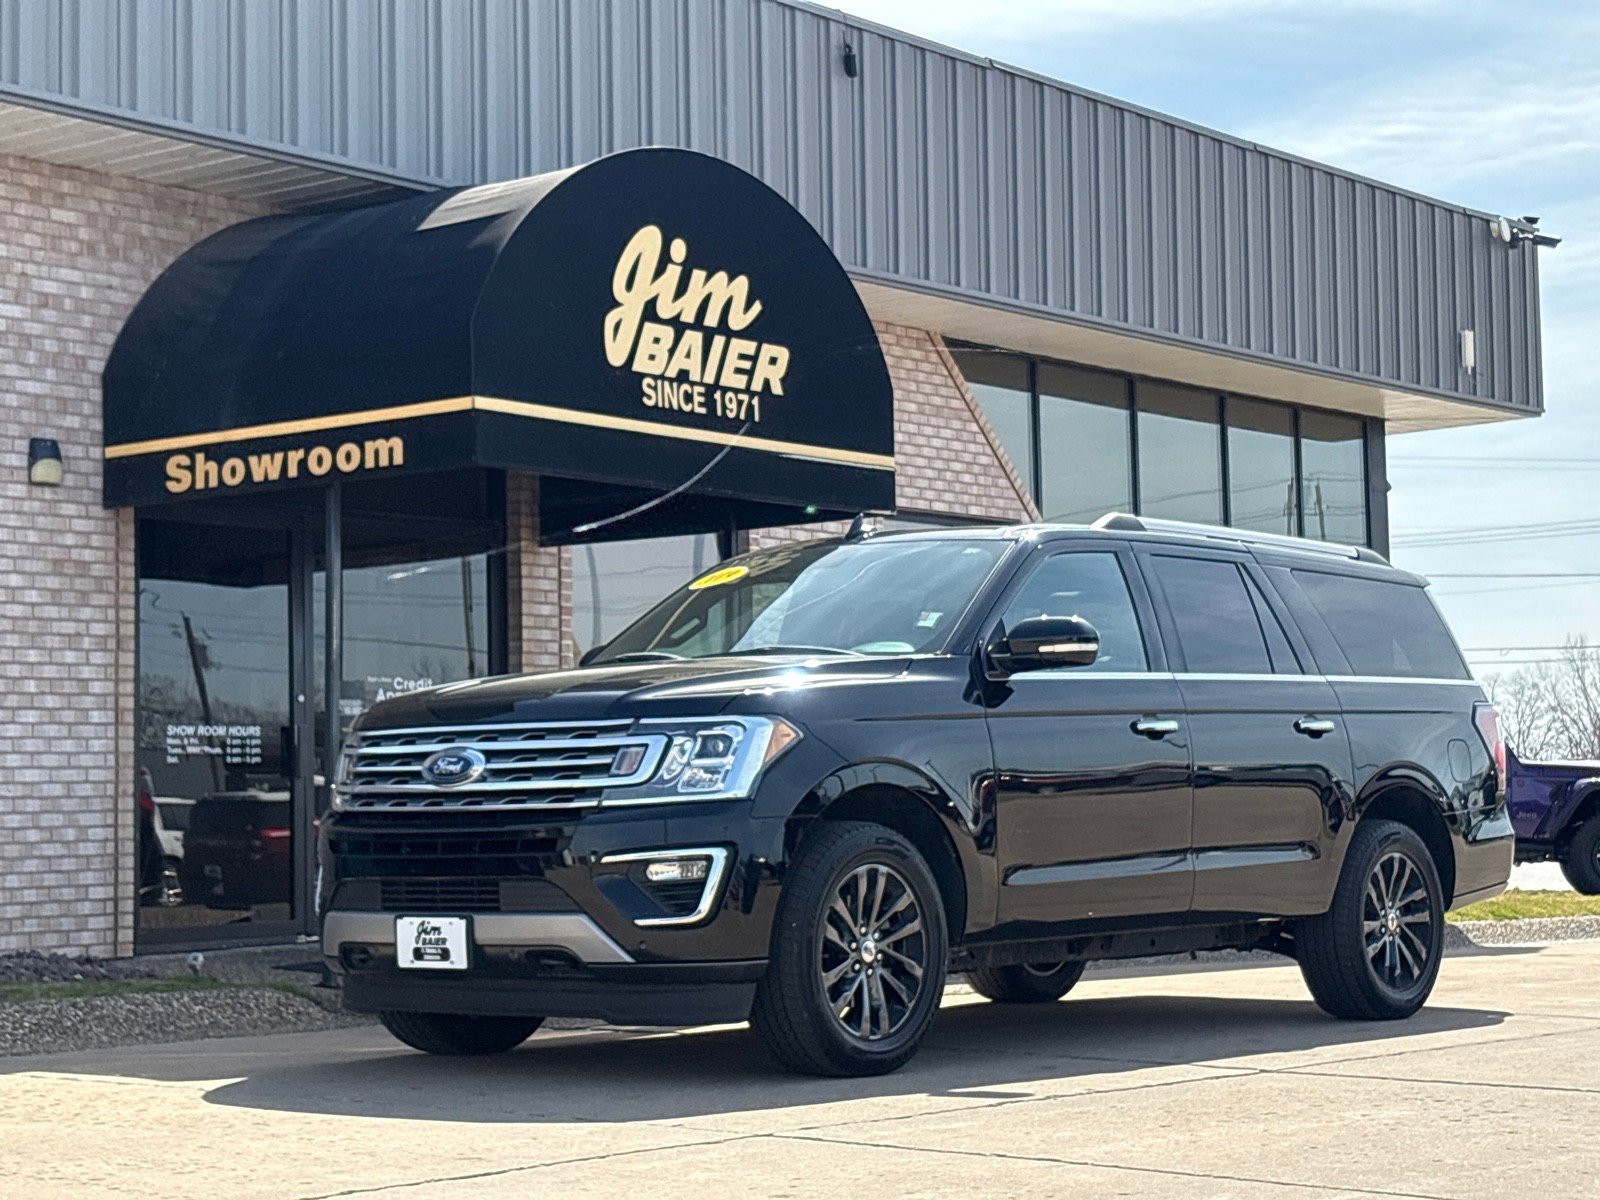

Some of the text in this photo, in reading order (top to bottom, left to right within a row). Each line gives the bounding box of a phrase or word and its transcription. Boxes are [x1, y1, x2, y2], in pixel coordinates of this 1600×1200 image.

[603, 224, 763, 367] Jim
[631, 321, 790, 396] BAIER
[641, 376, 760, 423] SINCE 1971
[165, 436, 404, 494] Showroom
[393, 676, 433, 690] Credit
[166, 724, 261, 737] SHOW ROOM HOURS
[433, 757, 464, 774] Ford
[1516, 811, 1537, 820] Jeep
[415, 920, 442, 945] Jim
[421, 937, 448, 946] BAIER
